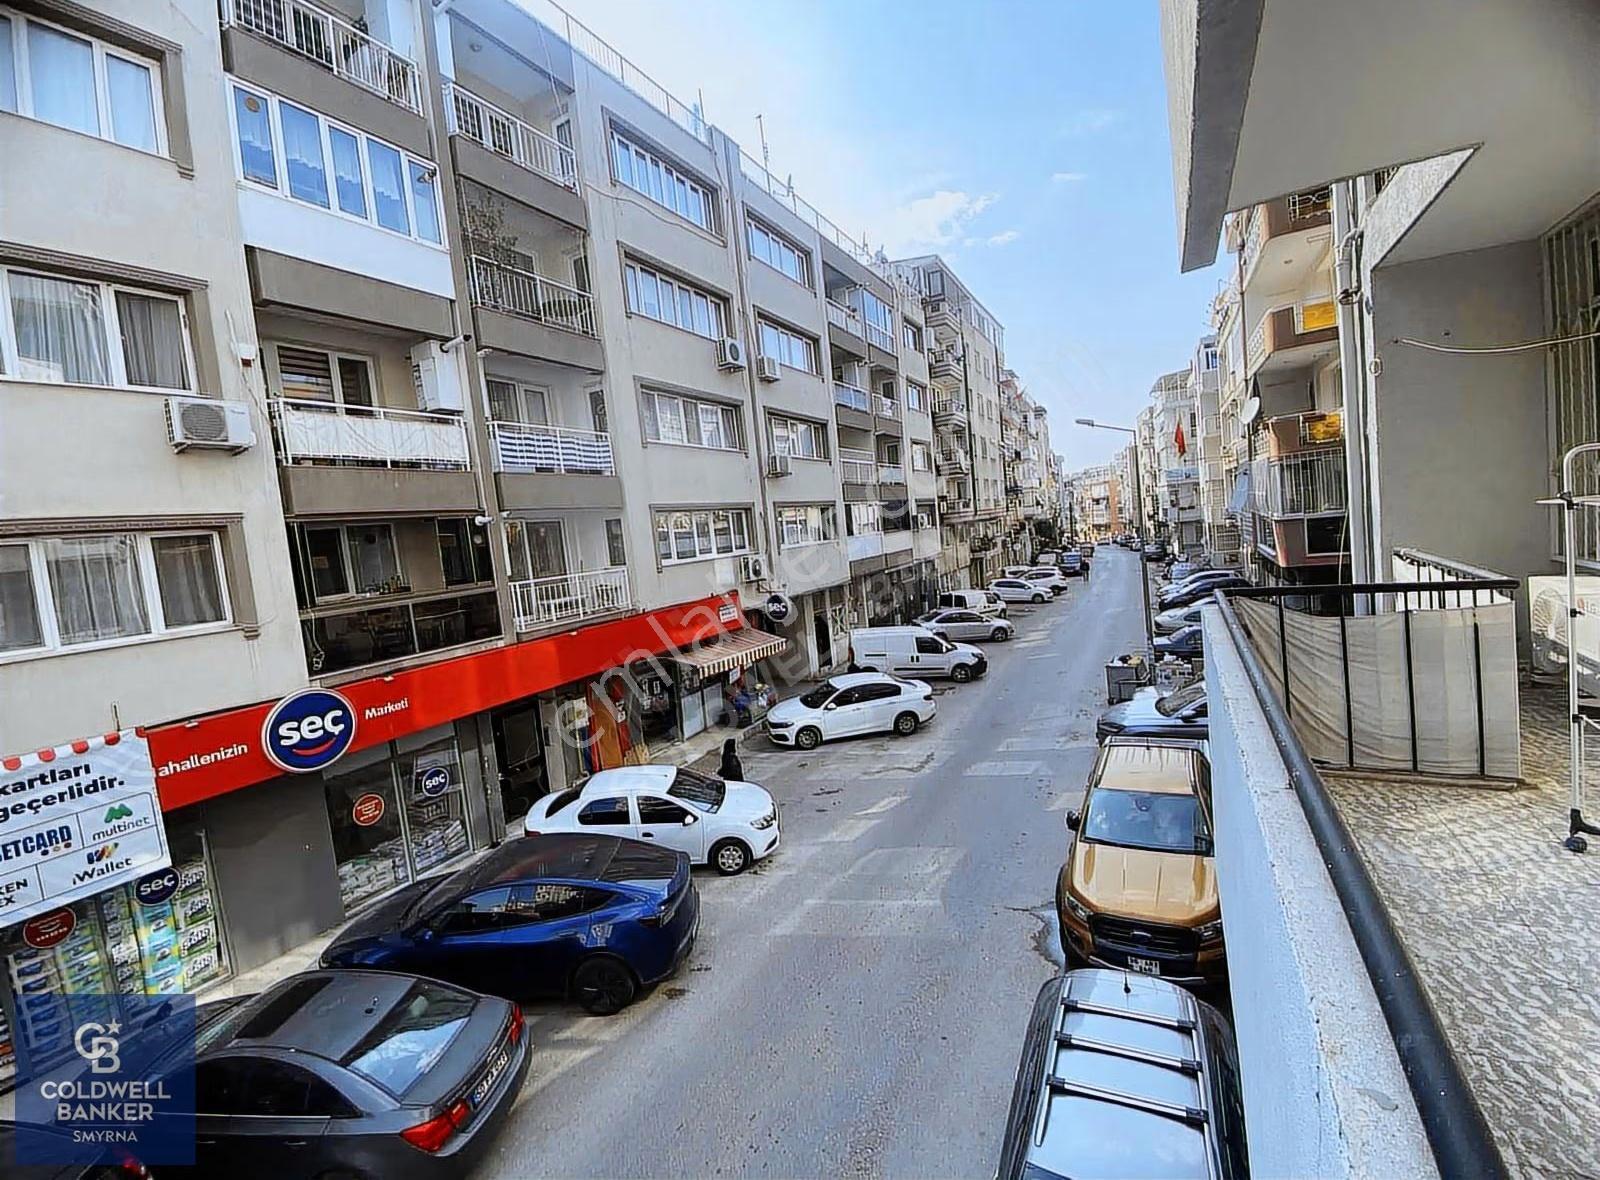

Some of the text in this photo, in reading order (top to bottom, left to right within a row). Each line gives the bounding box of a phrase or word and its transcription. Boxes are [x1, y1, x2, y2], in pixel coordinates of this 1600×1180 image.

[153, 697, 409, 778] ahallenizin seç Marketi
[92, 816, 151, 841] multinet
[0, 825, 72, 862] ETCARD
[72, 858, 133, 886] iWallet
[139, 874, 176, 896] seç
